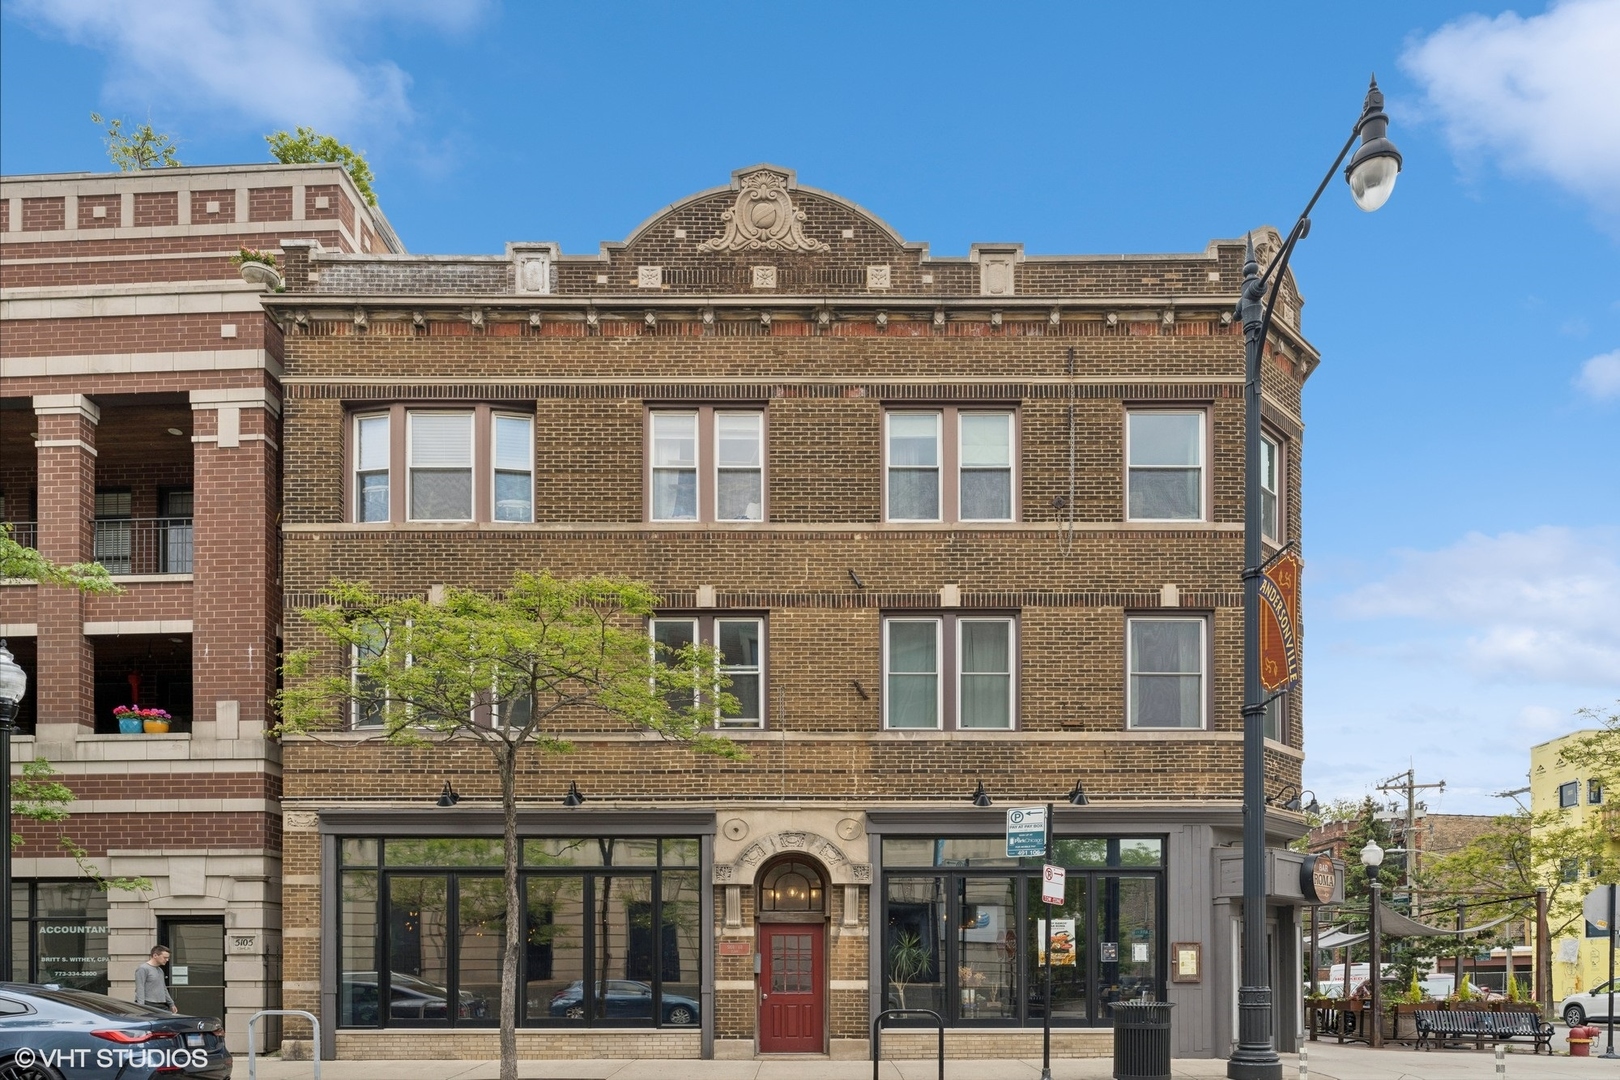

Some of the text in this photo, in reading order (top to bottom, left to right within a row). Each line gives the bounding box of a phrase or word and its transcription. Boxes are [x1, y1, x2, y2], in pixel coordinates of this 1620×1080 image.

[1259, 578, 1298, 683] ANDERSONVILLE
[1319, 864, 1329, 872] BAR
[1314, 873, 1334, 887] ROMA
[39, 926, 111, 934] ACCOUNTANT
[234, 938, 254, 947] 5105
